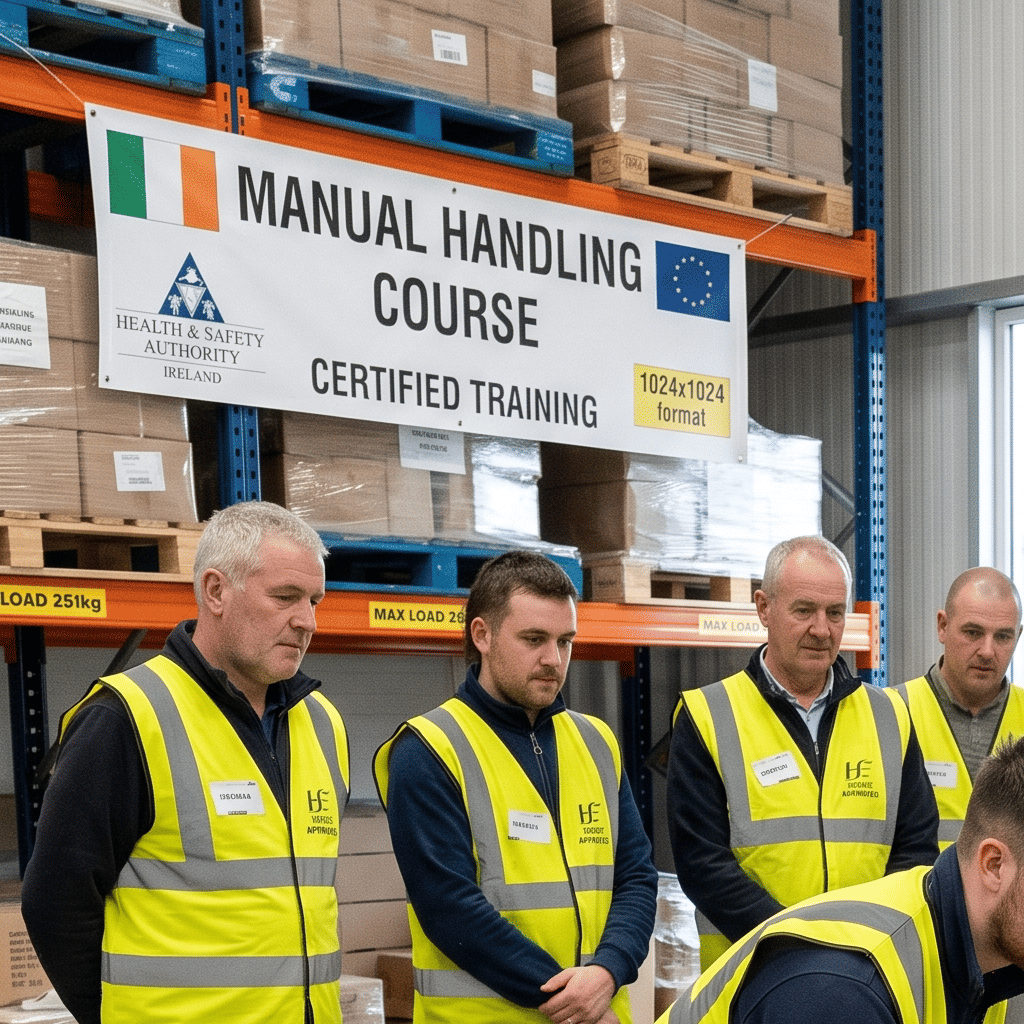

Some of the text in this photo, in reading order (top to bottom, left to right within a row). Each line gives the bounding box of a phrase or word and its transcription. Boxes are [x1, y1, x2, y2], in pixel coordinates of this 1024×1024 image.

[238, 165, 642, 292] MANUAL HANDLING
[374, 272, 539, 348] COURSE
[116, 314, 265, 348] HEALTH & SAFETY
[144, 339, 240, 365] AUTHORITY
[163, 366, 222, 384] IRELAND
[640, 372, 724, 403] 1024x1024
[311, 357, 598, 430] CERTIFIED TRAINING
[657, 401, 706, 427] format
[0, 592, 101, 613] LOAD 251kg
[374, 608, 405, 621] MAX
[409, 610, 445, 622] LOAD
[704, 620, 760, 631] MAX LOAD
